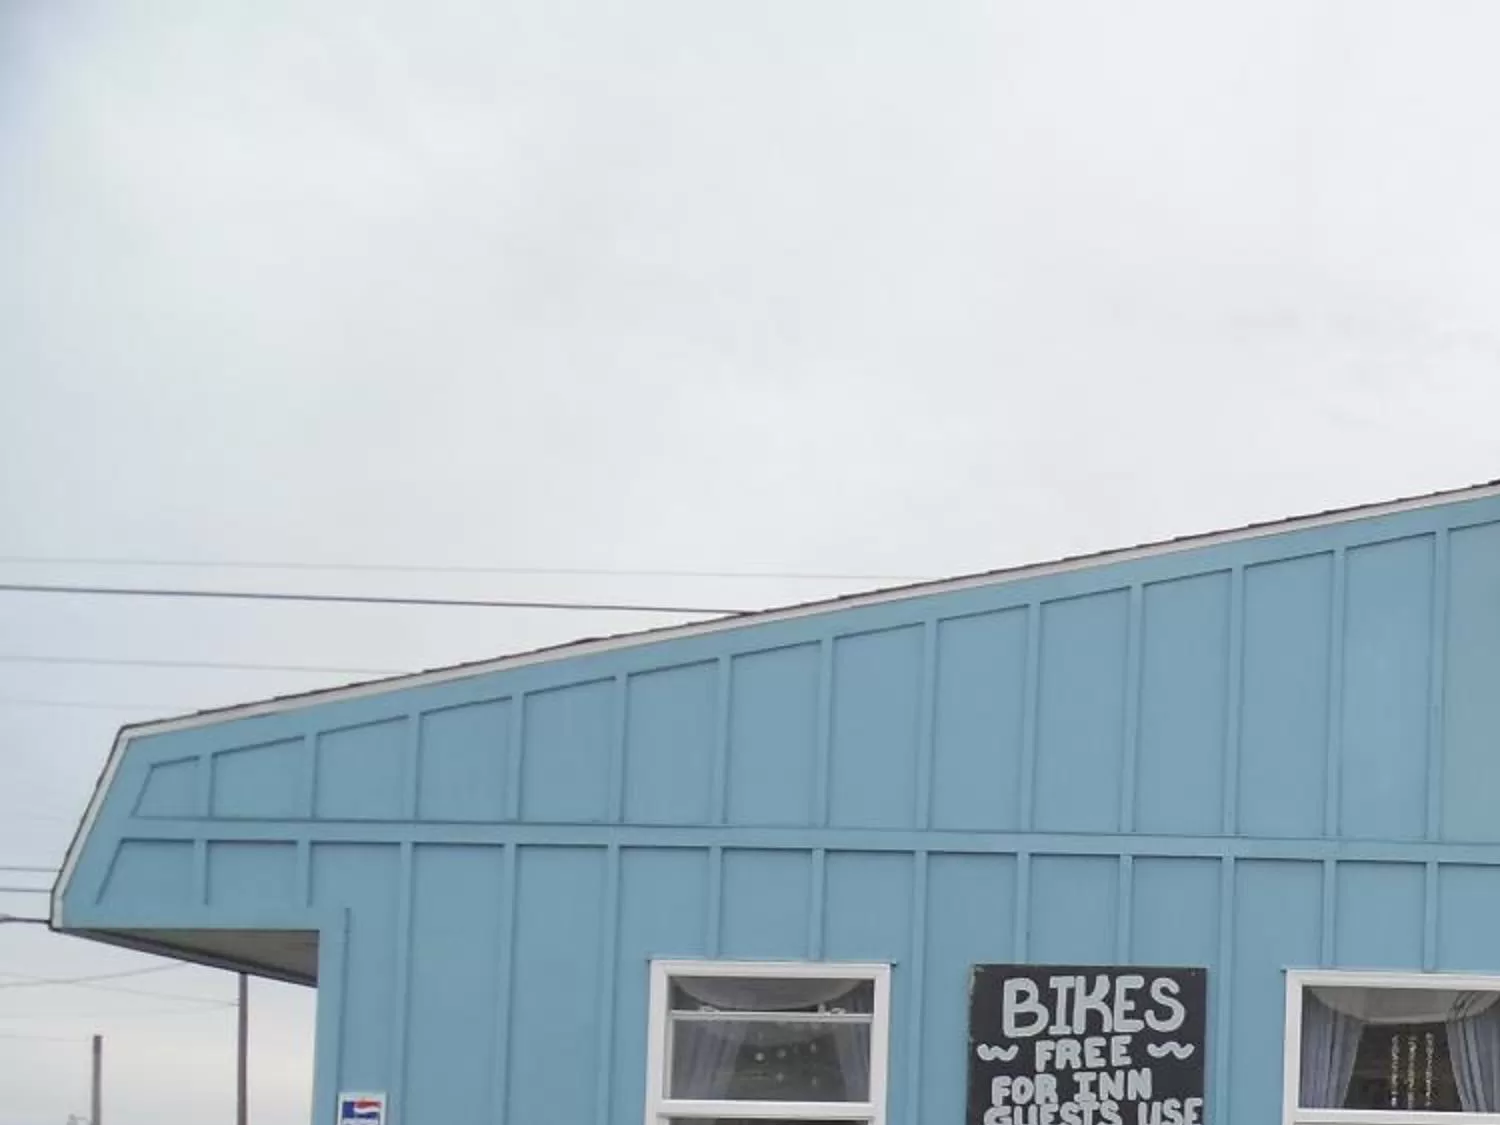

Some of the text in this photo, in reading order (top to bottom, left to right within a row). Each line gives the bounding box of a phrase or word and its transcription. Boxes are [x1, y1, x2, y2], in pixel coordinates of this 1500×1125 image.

[1002, 974, 1186, 1038] BIKES
[1035, 1035, 1132, 1072] FREE
[991, 1067, 1152, 1106] FOR INN
